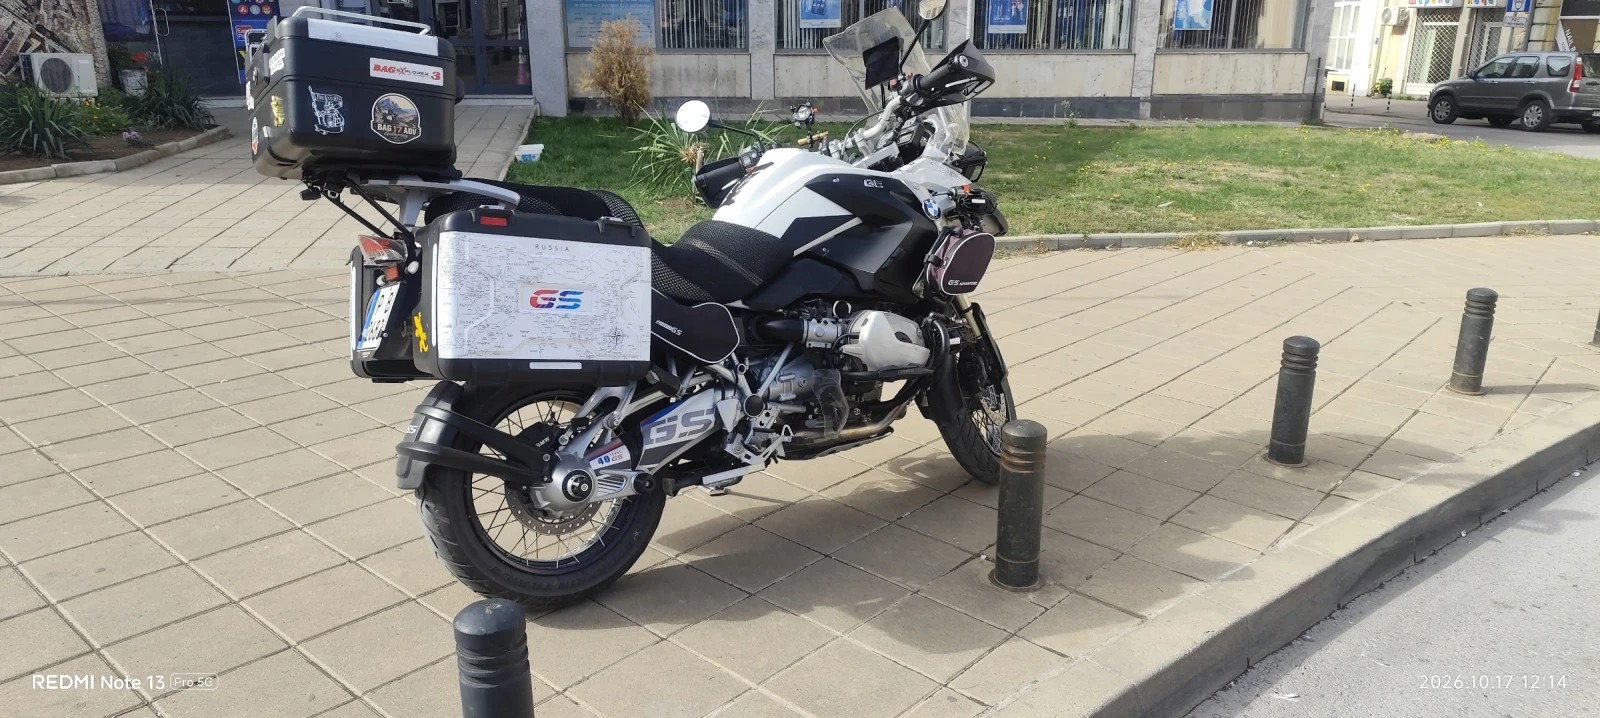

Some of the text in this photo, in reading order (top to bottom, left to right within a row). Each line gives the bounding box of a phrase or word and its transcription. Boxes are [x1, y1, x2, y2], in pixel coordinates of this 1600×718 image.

[1564, 28, 1575, 46] NAIL
[372, 64, 396, 73] BAG
[431, 71, 441, 80] 3
[377, 123, 417, 135] BAG 17 ADV
[535, 243, 570, 252] RUSSIA
[529, 289, 584, 310] GS
[405, 424, 418, 434] GS
[641, 407, 714, 446] GS
[597, 454, 623, 465] 40 GS
